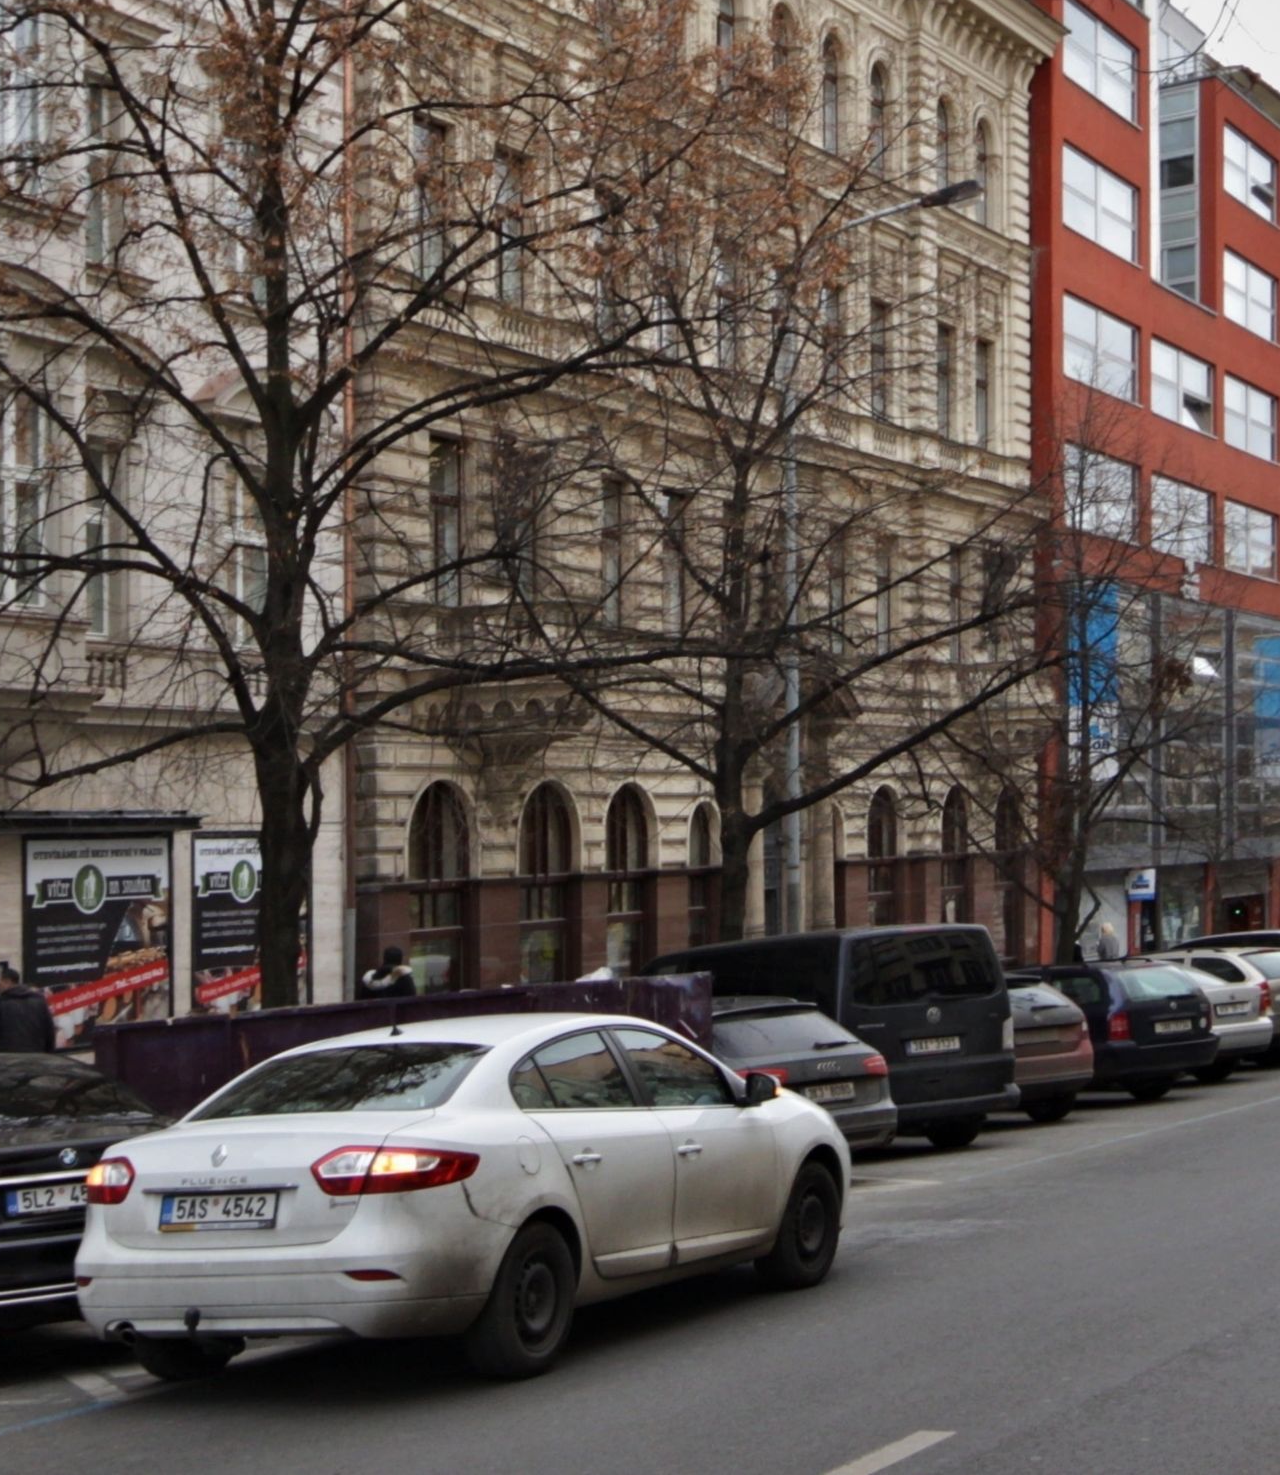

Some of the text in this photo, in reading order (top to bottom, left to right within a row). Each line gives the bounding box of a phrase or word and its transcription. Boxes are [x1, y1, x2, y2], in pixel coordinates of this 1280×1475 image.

[181, 1176, 248, 1186] FLUENCE
[22, 1185, 88, 1209] 5L2 45
[176, 1196, 267, 1219] 5AS 4542
